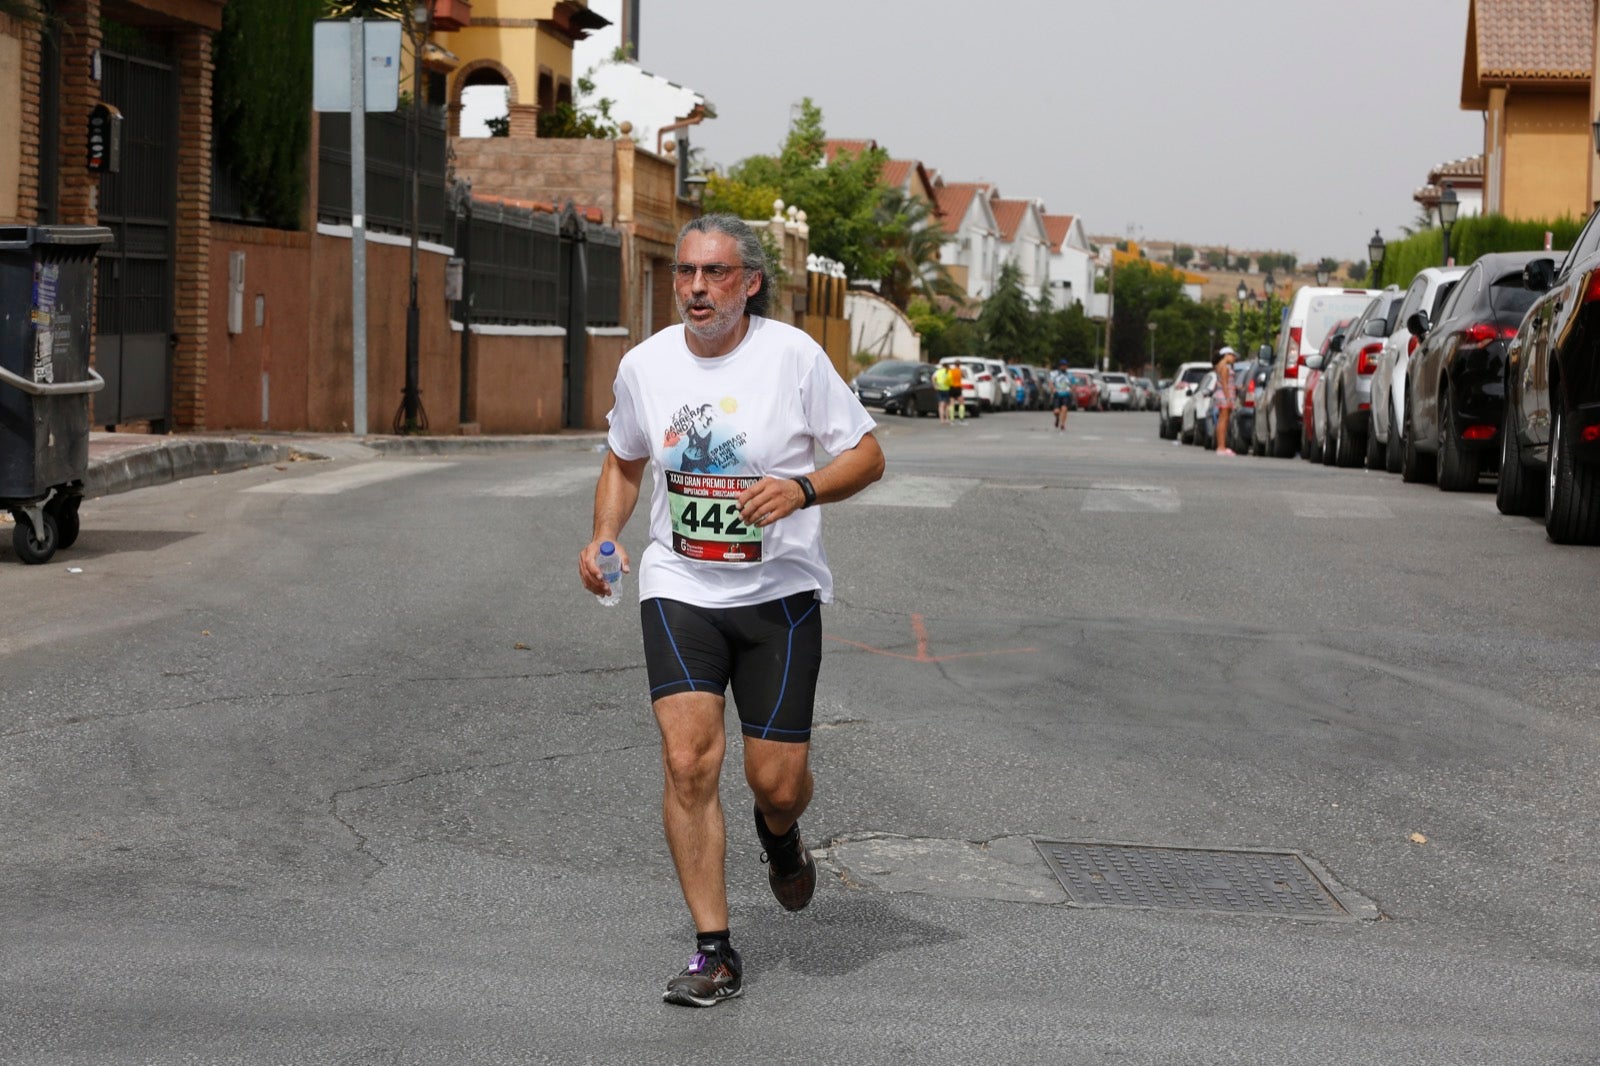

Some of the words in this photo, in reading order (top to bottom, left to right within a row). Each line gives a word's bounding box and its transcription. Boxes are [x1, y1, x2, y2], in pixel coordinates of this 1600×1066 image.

[685, 474, 701, 487] GRAN
[702, 477, 726, 489] PREMIO
[727, 478, 736, 489] DE
[684, 487, 709, 496] DIPUTACIÓN
[681, 501, 747, 535] 442
